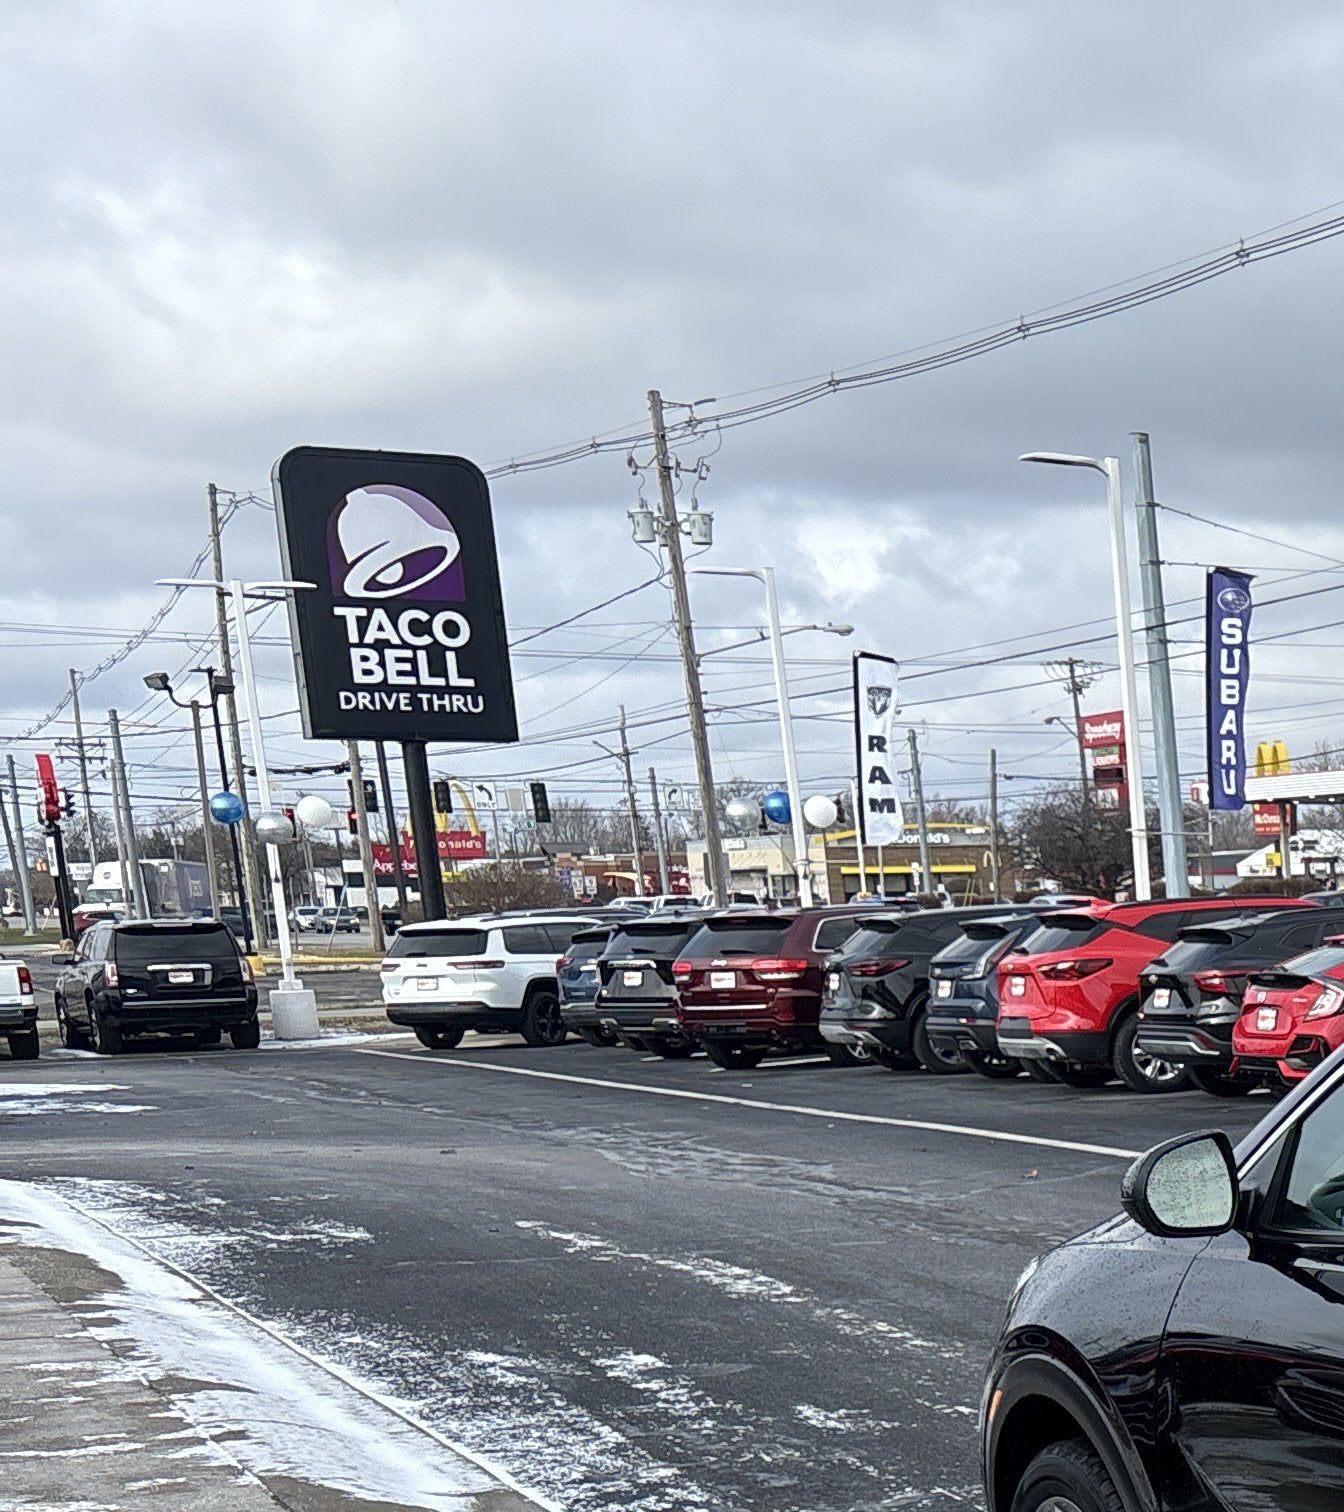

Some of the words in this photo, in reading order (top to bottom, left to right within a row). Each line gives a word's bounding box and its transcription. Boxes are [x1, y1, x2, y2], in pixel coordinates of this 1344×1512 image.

[333, 606, 471, 648] TACO
[349, 647, 476, 688] BELL
[338, 690, 413, 712] DRIVE
[417, 692, 485, 714] THRU
[1219, 617, 1243, 796] SUBARU
[867, 734, 897, 814] RAM
